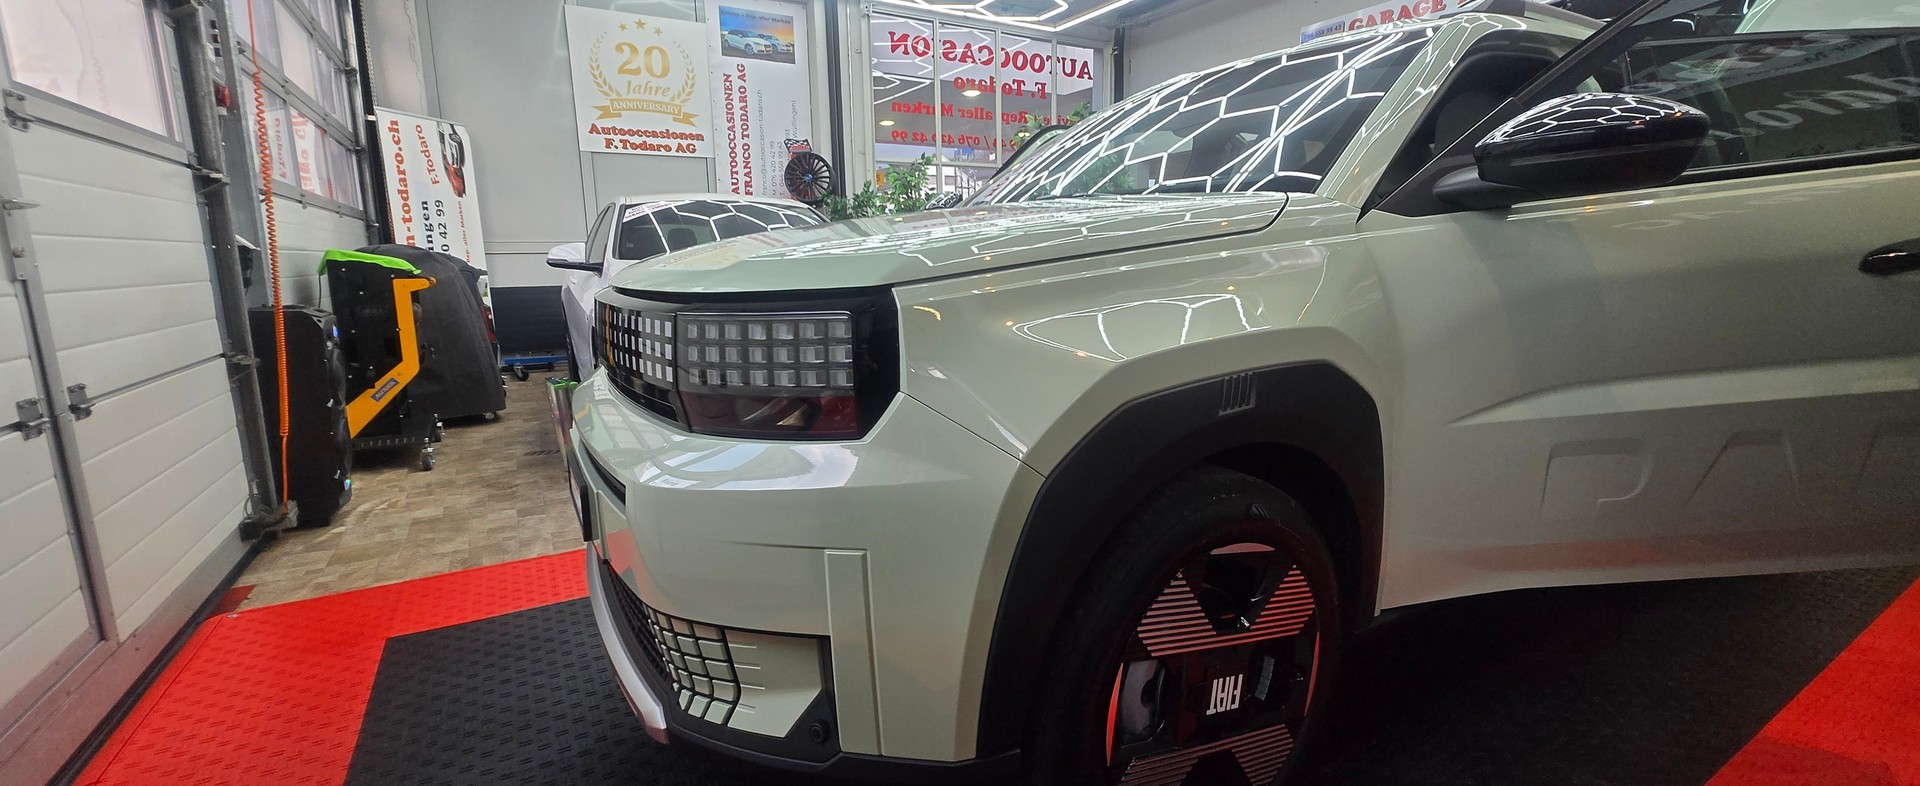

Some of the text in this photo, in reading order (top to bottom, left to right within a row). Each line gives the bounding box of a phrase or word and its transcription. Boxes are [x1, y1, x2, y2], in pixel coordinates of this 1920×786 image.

[1349, 0, 1447, 31] GARAGE
[615, 41, 671, 79] 20
[625, 80, 671, 97] Jahre
[612, 101, 680, 115] ANNIVERSARY
[588, 122, 705, 142] Autooccasionen
[723, 73, 740, 195] AUTOOCCASIONEN
[737, 63, 753, 195] FRANCO TODARO AG
[604, 137, 697, 154] F. Todaro AG
[769, 140, 776, 150] 99
[770, 150, 776, 160] 42
[434, 199, 444, 217] 99
[437, 222, 449, 240] 42
[1206, 674, 1243, 715] FIAT
